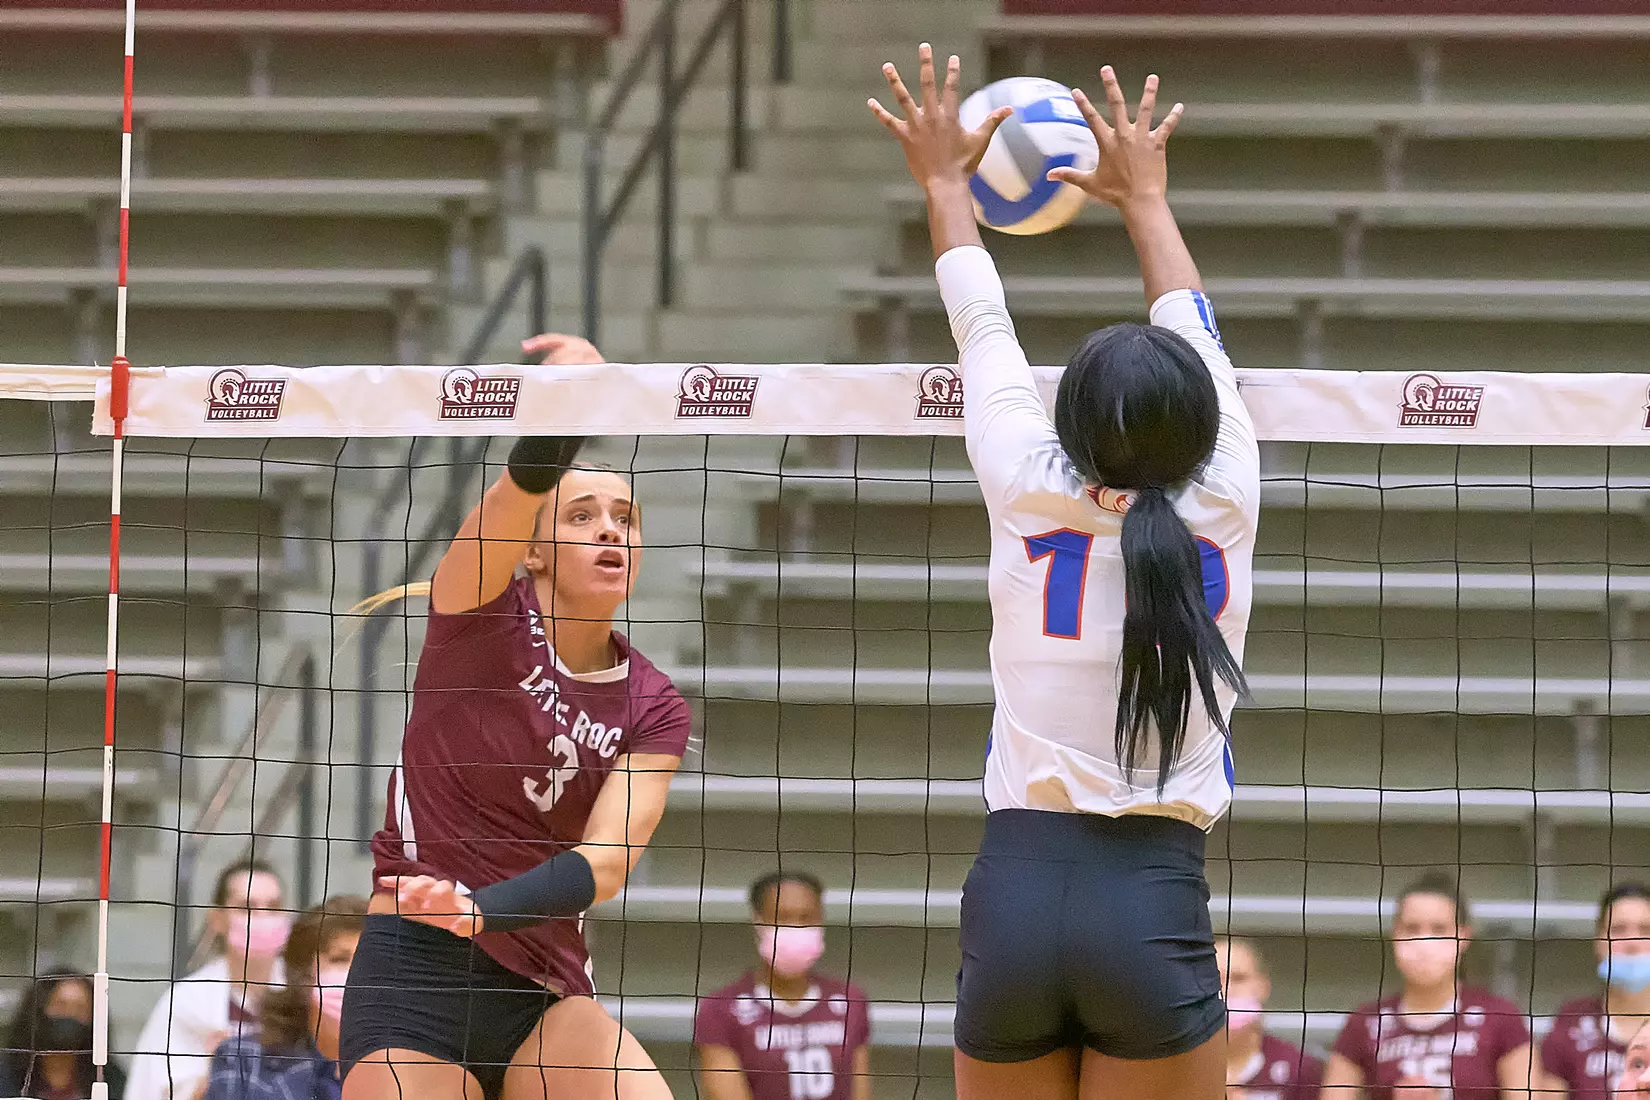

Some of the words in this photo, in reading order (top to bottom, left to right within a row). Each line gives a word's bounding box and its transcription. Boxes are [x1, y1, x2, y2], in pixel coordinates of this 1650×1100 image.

[242, 383, 283, 393] LITTLE
[476, 380, 518, 391] LITTLE
[714, 378, 756, 389] LITTLE
[473, 392, 516, 402] ROCK
[711, 391, 753, 401] ROCK
[1437, 388, 1482, 399] LITTLE
[239, 394, 280, 404] ROCK
[682, 406, 747, 415] VOLLEYBALL
[1435, 400, 1478, 411] ROCK
[211, 409, 275, 418] VOLLEYBALL
[444, 407, 511, 416] VOLLEYBALL
[1404, 415, 1472, 425] VOLLEYBALL
[570, 710, 620, 761] ROC
[523, 733, 579, 812] 3
